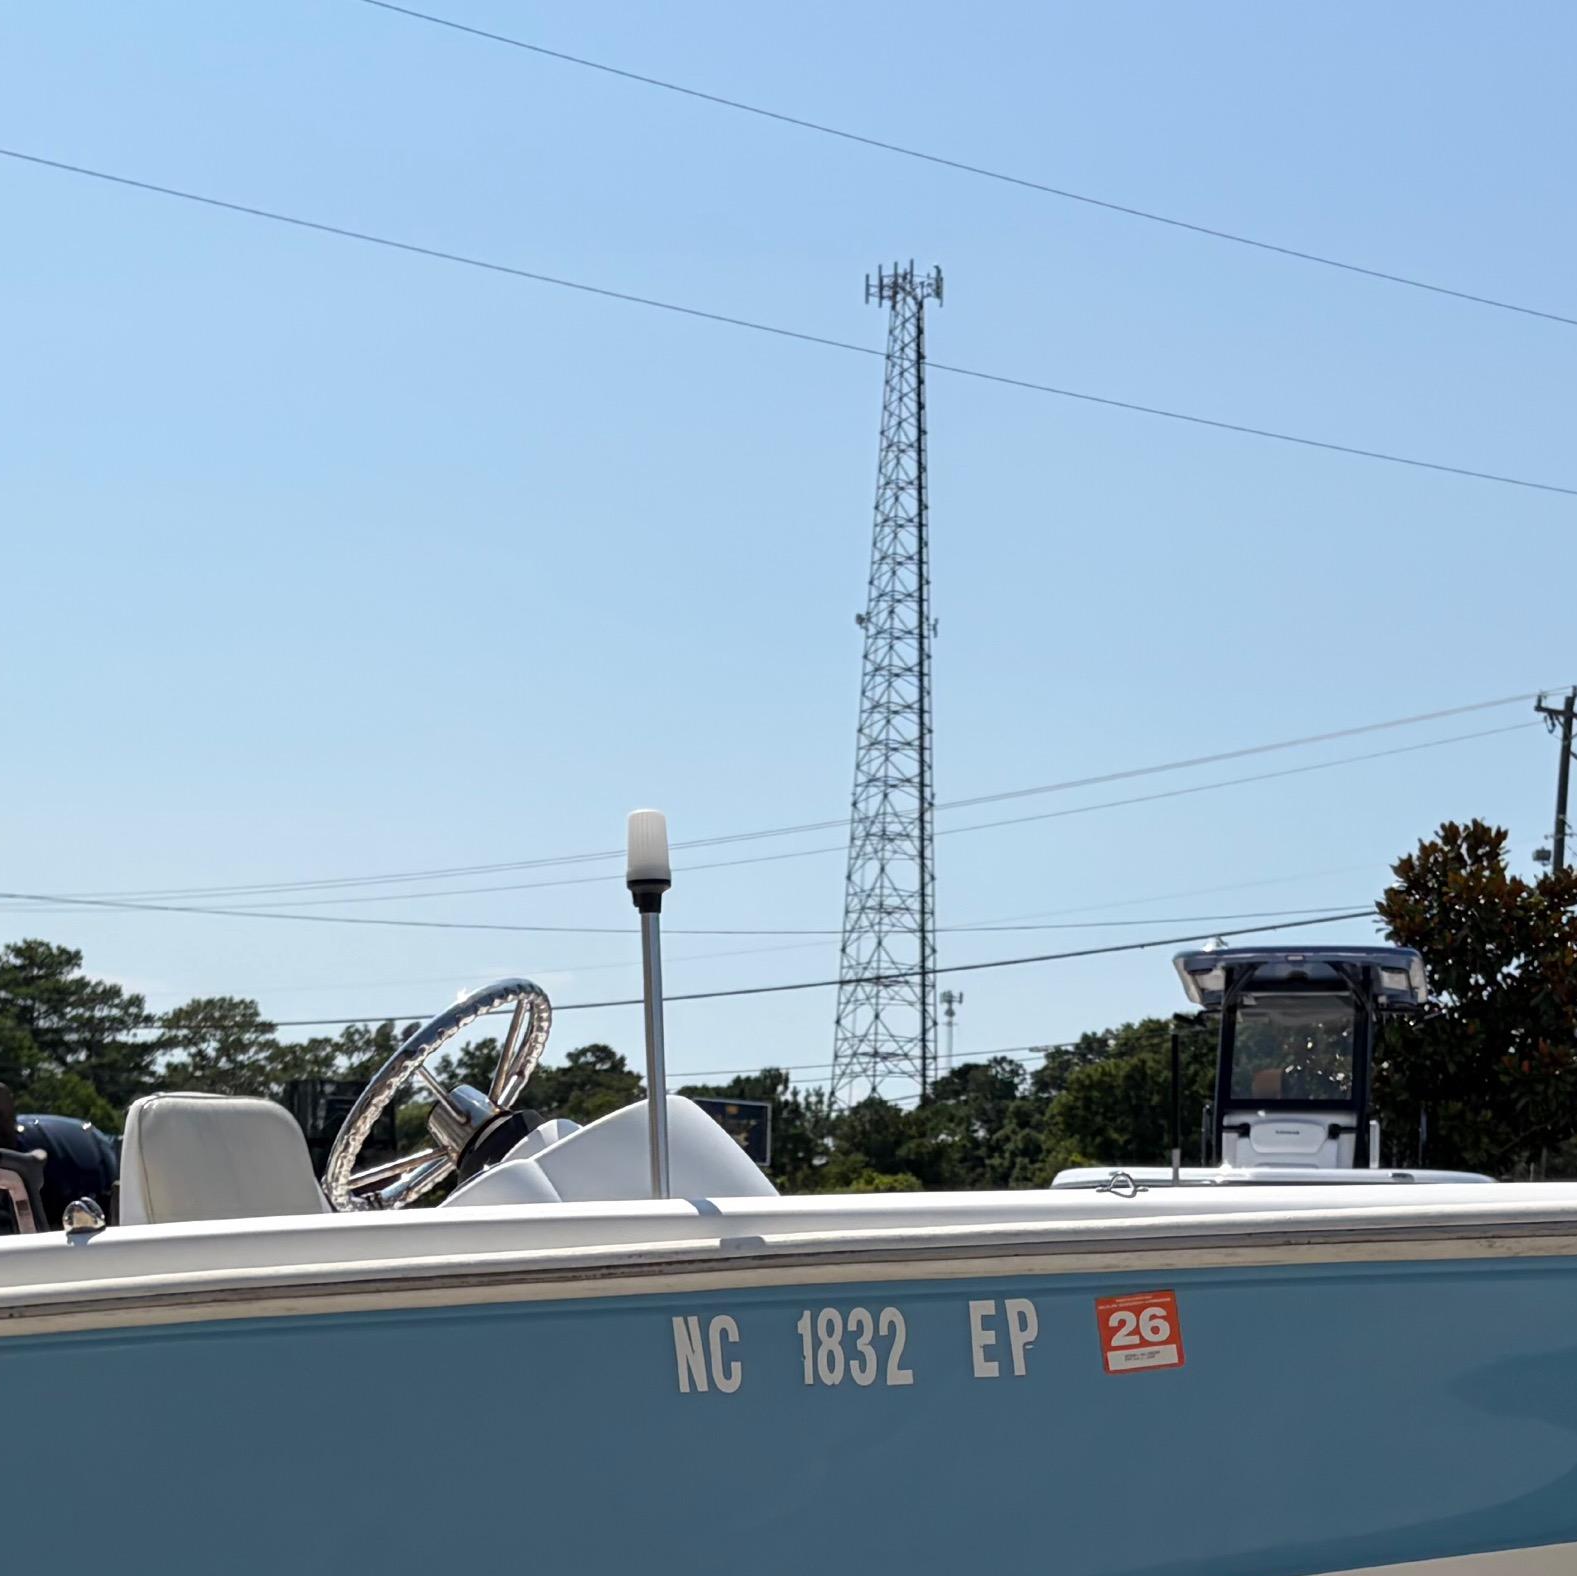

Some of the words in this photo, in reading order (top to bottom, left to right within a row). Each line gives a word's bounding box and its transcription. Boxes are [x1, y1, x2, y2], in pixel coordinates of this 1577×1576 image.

[671, 1314, 742, 1393] NC
[797, 1306, 914, 1386] 1832
[968, 1298, 1040, 1378] EP
[1108, 1306, 1171, 1347] 26
